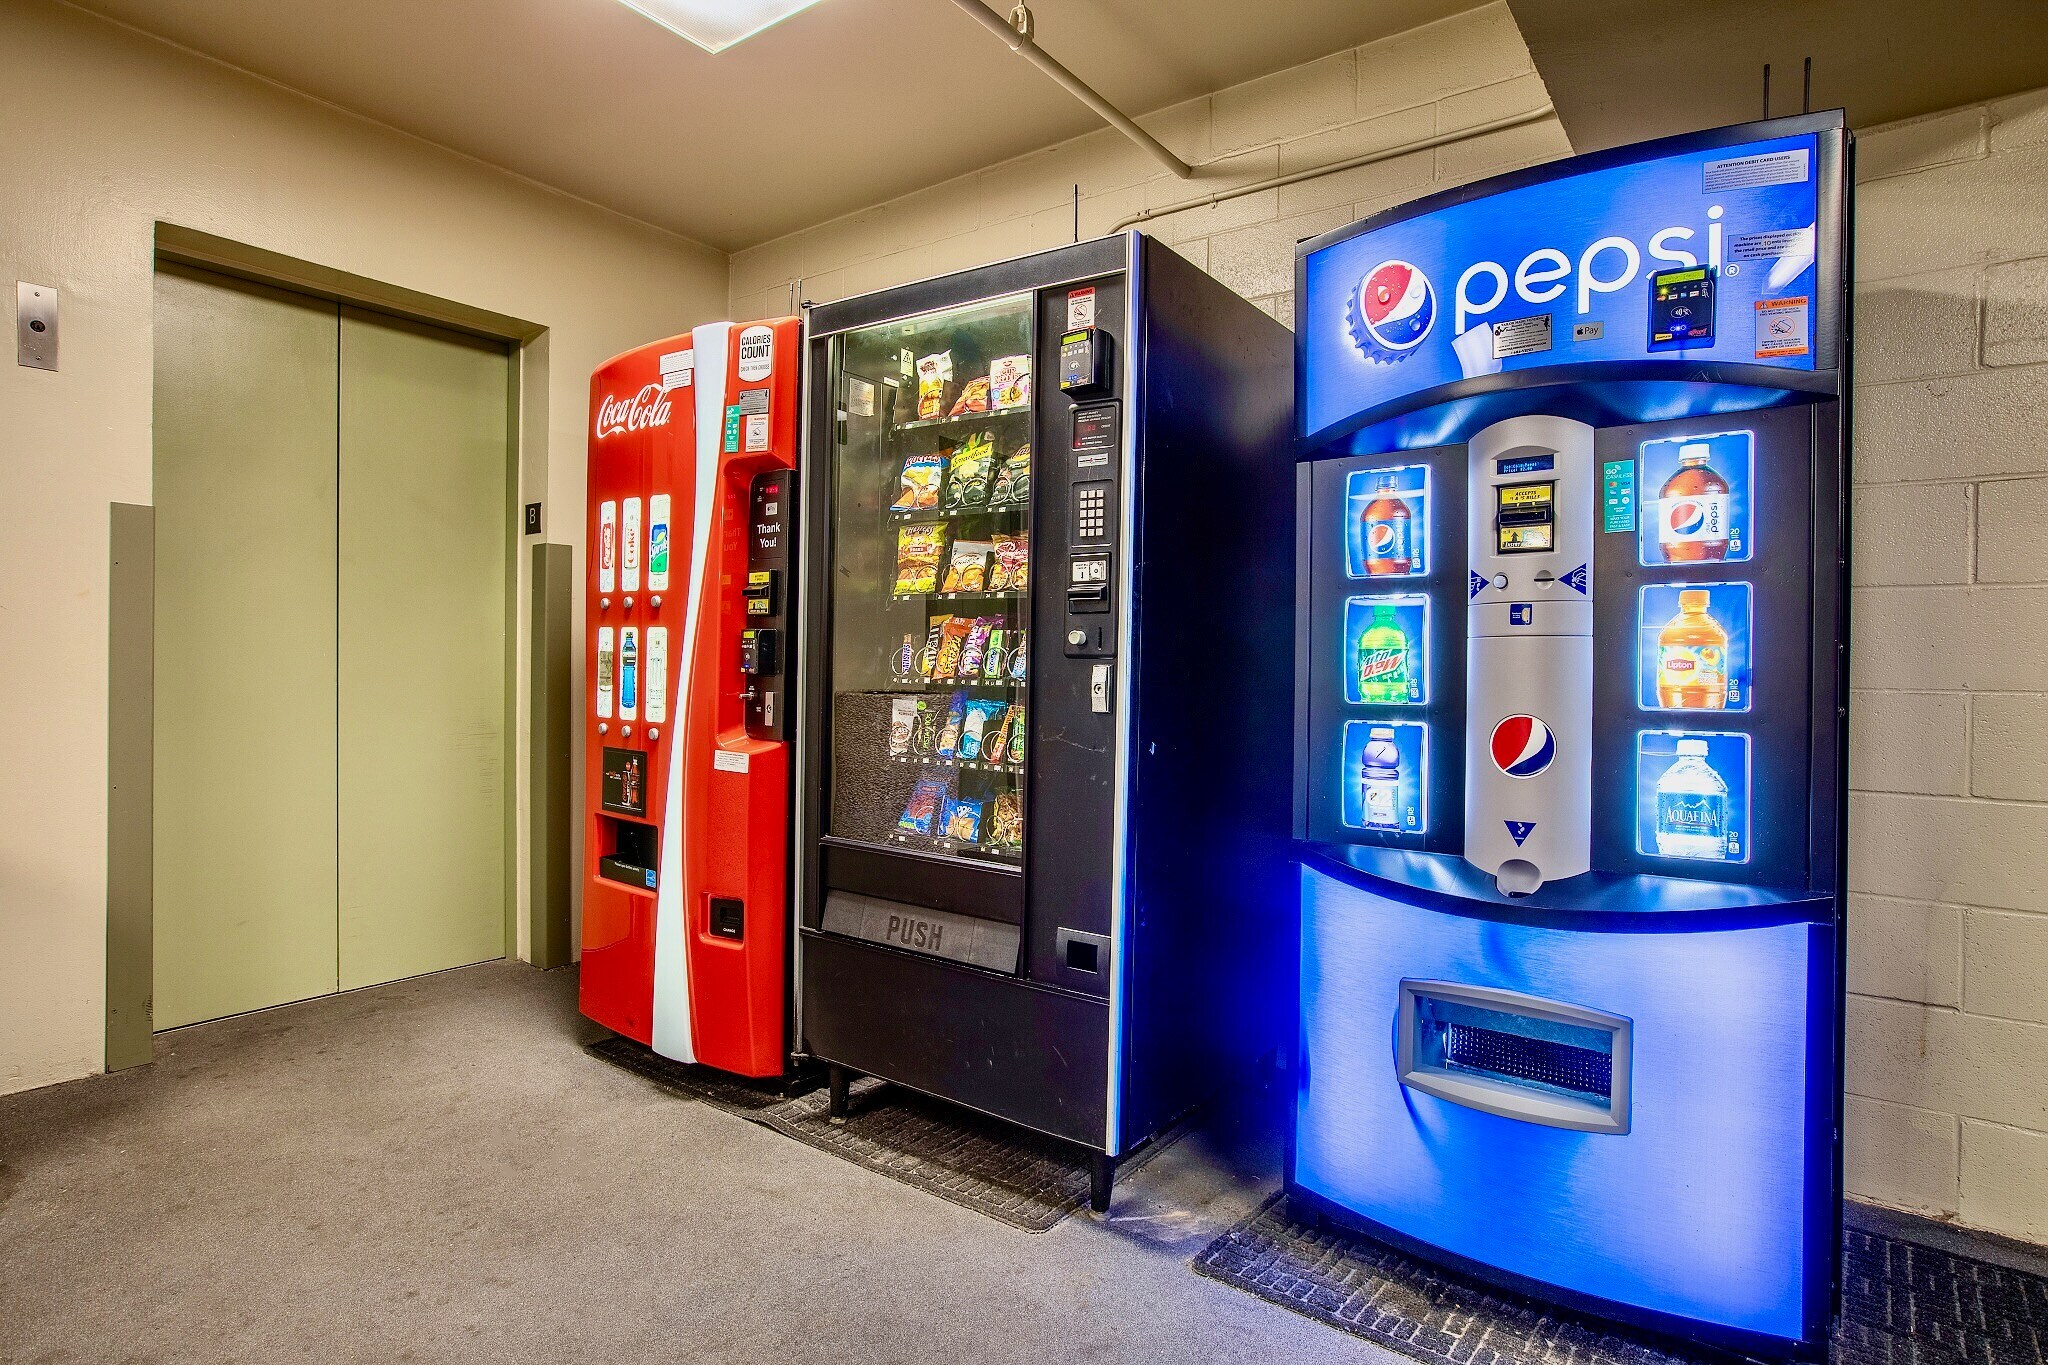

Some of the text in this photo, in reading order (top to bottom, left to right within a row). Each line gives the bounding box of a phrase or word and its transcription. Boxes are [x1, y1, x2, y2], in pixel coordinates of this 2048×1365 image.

[1455, 204, 1724, 333] pepsi
[1584, 327, 1598, 336] Pay
[742, 334, 771, 346] CALORIES
[742, 345, 770, 360] COUNT
[597, 383, 672, 439] Coca-Cola
[530, 508, 535, 524] B
[757, 522, 780, 534] Thank
[760, 537, 776, 548] You!
[902, 644, 911, 673] SATISFIES
[1666, 806, 1719, 827] AQUAFINA
[886, 915, 943, 952] PUSH
